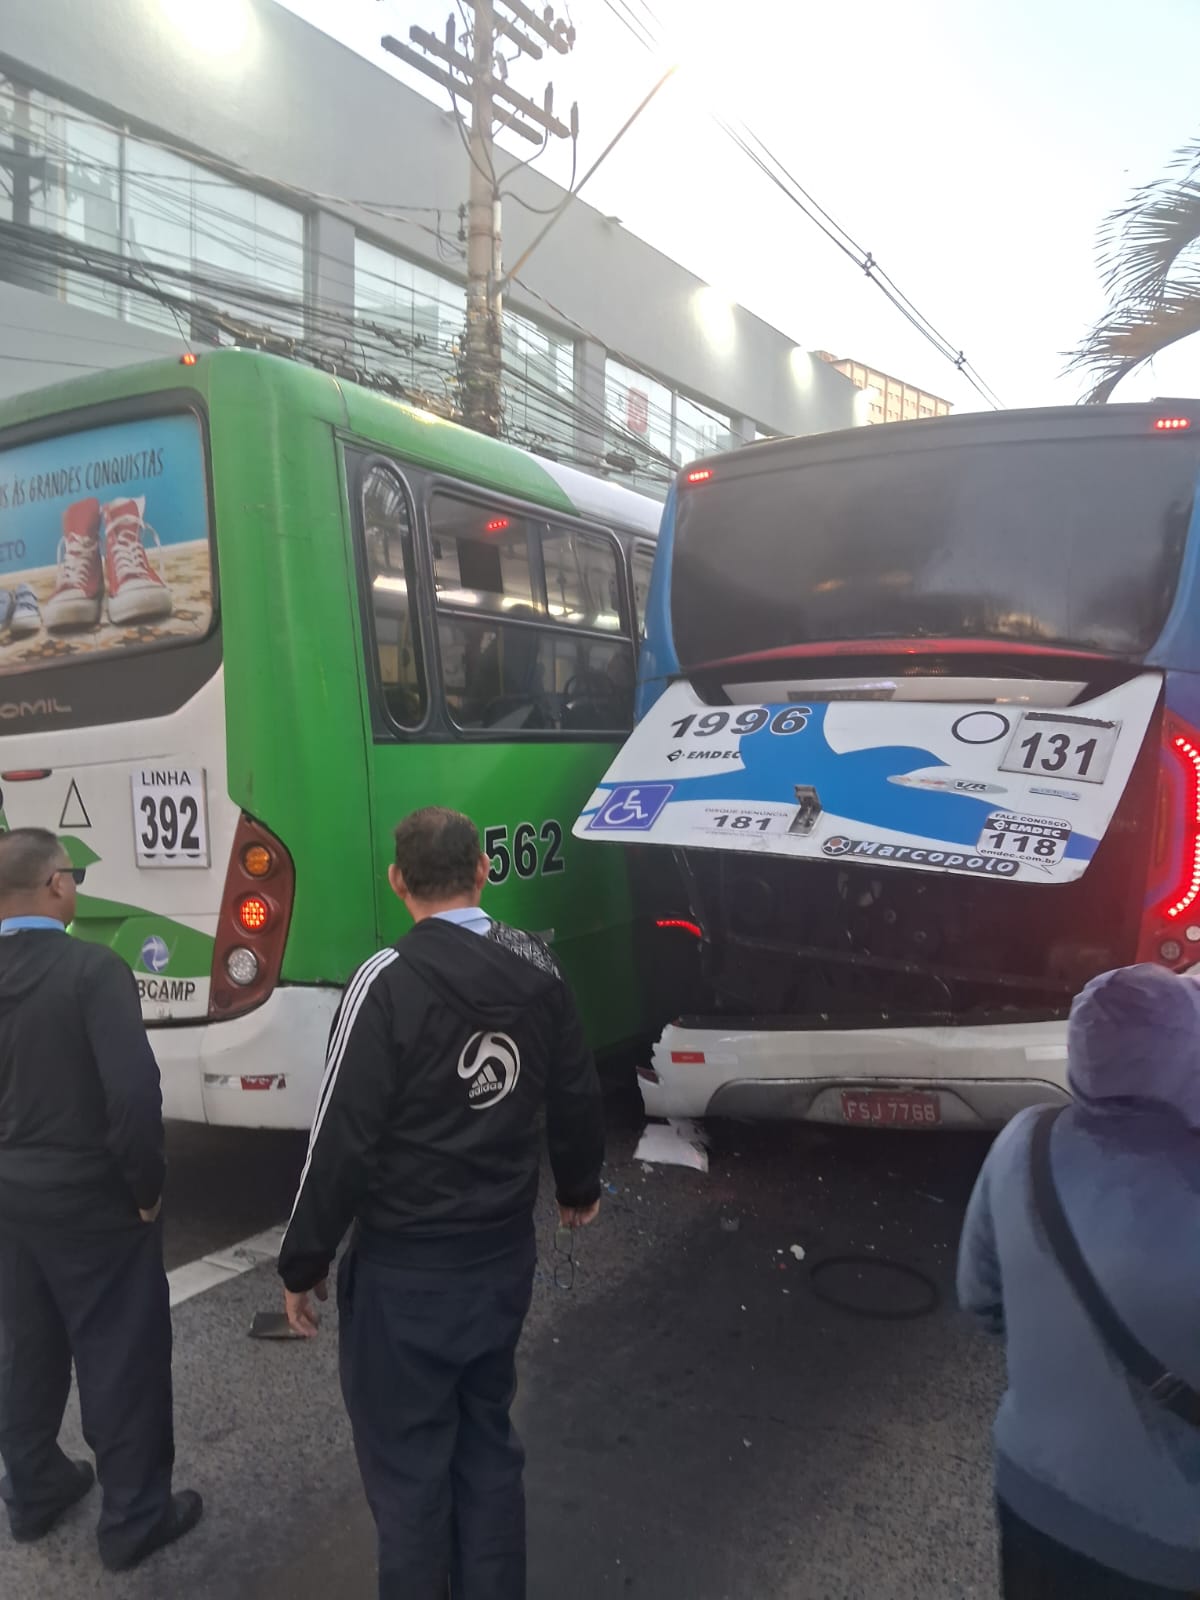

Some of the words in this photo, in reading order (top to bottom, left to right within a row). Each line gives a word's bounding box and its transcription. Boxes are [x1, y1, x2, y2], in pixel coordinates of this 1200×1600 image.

[29, 465, 81, 503] GRANDES
[86, 447, 165, 491] CONQUISTAS
[671, 706, 811, 738] 1996
[686, 750, 742, 760] EMDEC
[1020, 732, 1099, 776] 131
[141, 770, 192, 787] LINHA
[140, 796, 200, 850] 392
[713, 814, 772, 831] 181
[995, 813, 1018, 821] FALE
[1020, 815, 1068, 828] CONOSCO
[1009, 823, 1062, 837] EMDEC
[484, 819, 566, 885] 562
[989, 832, 1057, 857] 118
[854, 841, 1015, 873] Marcopolo
[980, 848, 1057, 865] emdec.com.br
[469, 1081, 503, 1099] adidas
[847, 1101, 882, 1120] FSJ
